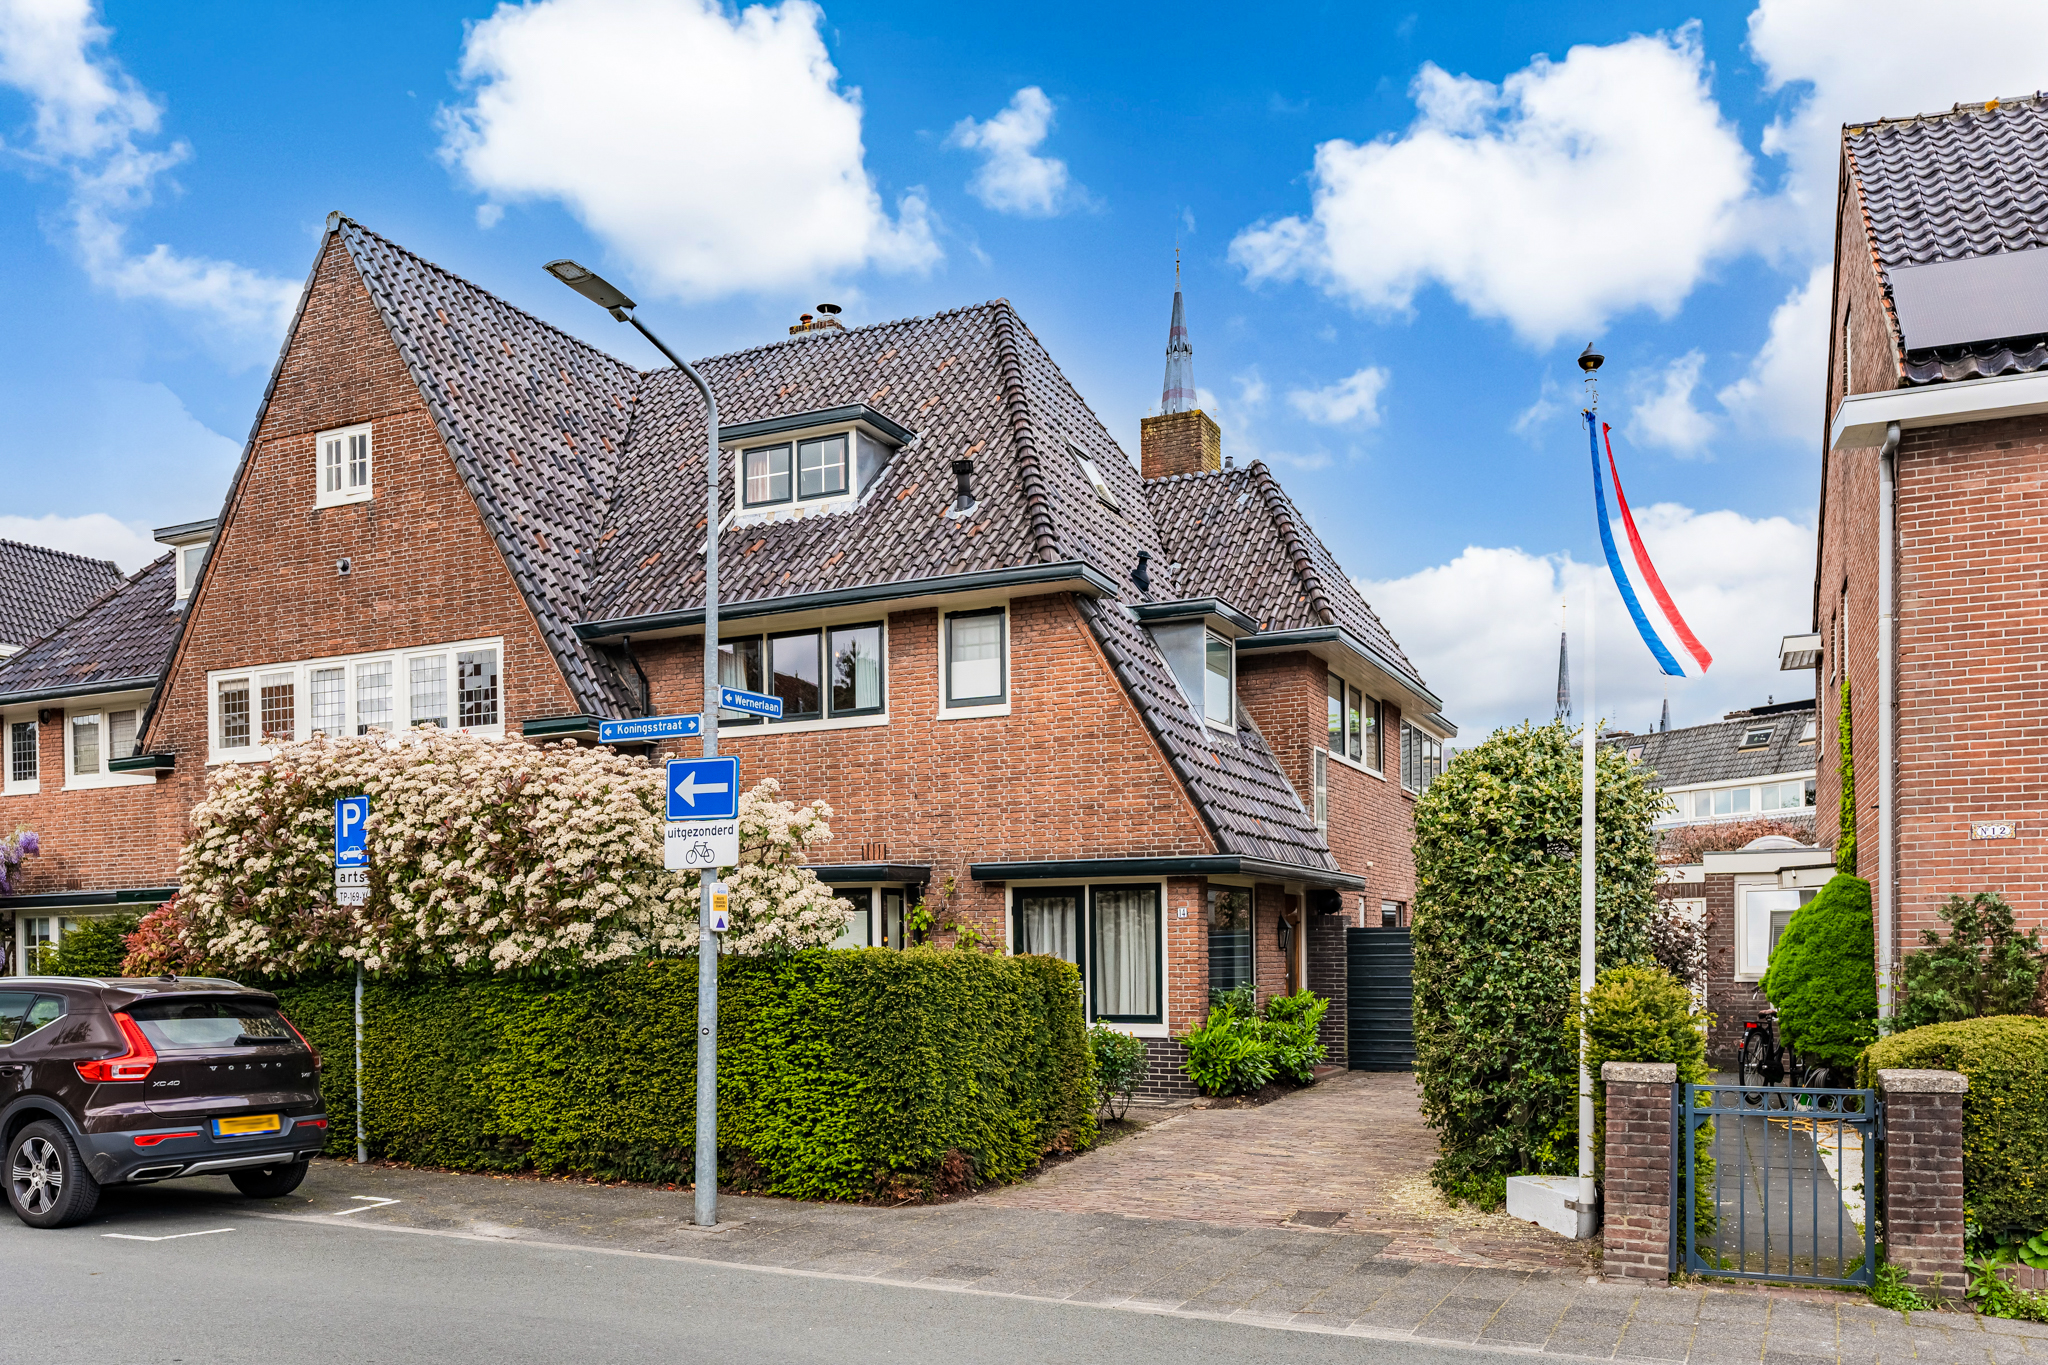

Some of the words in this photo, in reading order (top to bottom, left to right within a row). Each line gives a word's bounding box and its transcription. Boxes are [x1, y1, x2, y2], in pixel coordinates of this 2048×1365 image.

[735, 695, 779, 713] Wernerlaan
[617, 720, 683, 736] Koningsstraat
[343, 803, 361, 837] P
[667, 824, 734, 841] uitgezonderd
[340, 871, 365, 883] arts
[1178, 908, 1186, 918] 14
[210, 1062, 282, 1071] VOLVO
[153, 1080, 181, 1088] XC40
